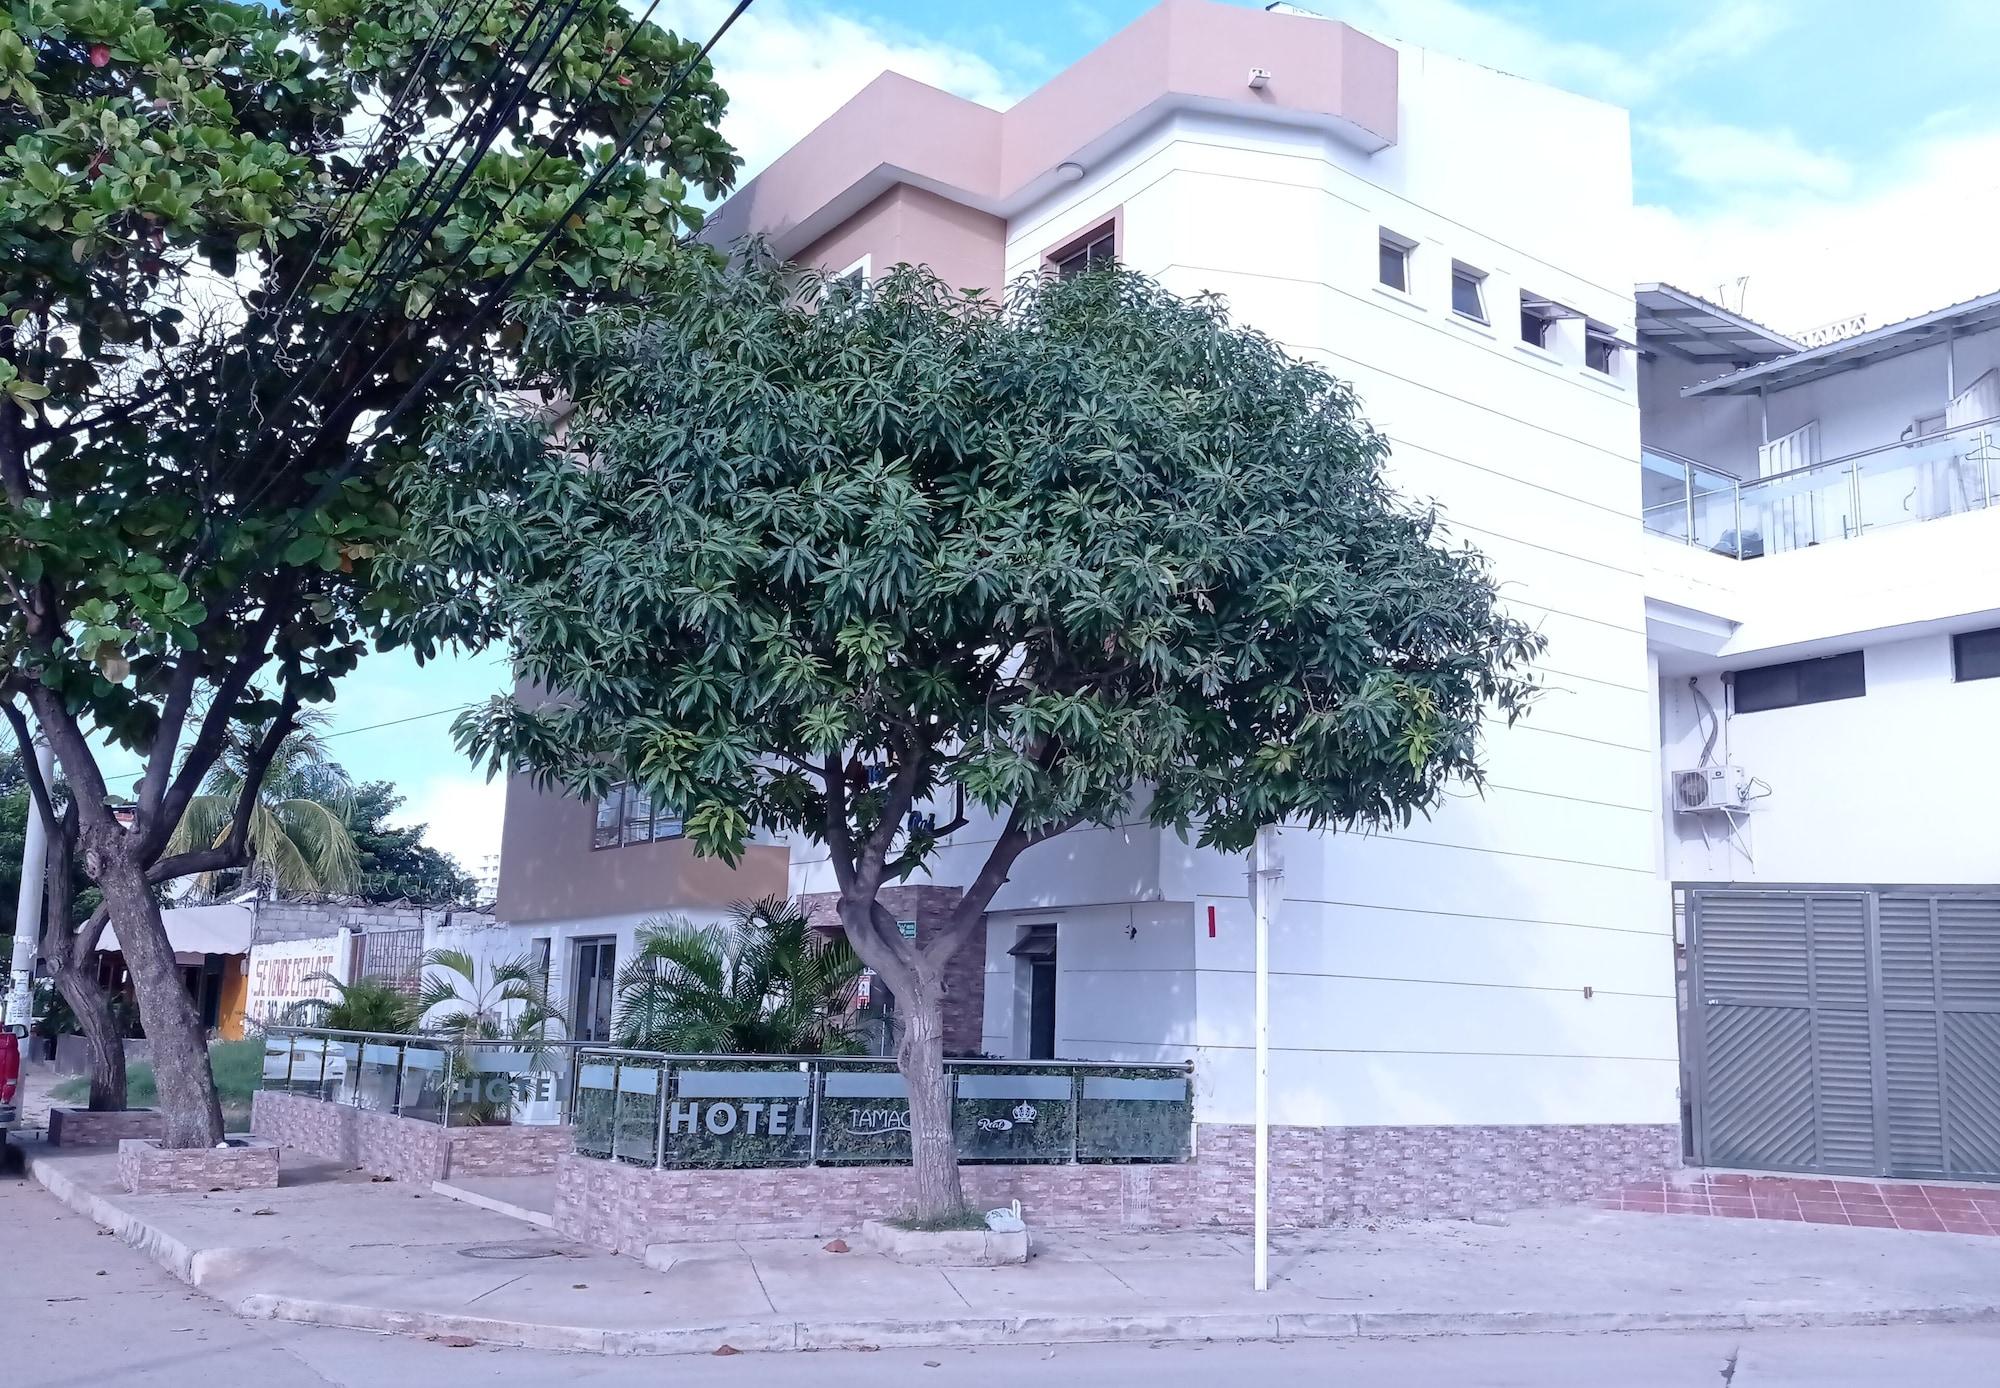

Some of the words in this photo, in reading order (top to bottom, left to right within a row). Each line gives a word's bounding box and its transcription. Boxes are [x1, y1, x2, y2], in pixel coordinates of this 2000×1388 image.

[253, 960, 269, 996] SE
[456, 1078, 569, 1103] HOTEL
[669, 1102, 811, 1136] HOTEL
[849, 1108, 912, 1129] TAMAC
[977, 1118, 1012, 1131] Real
